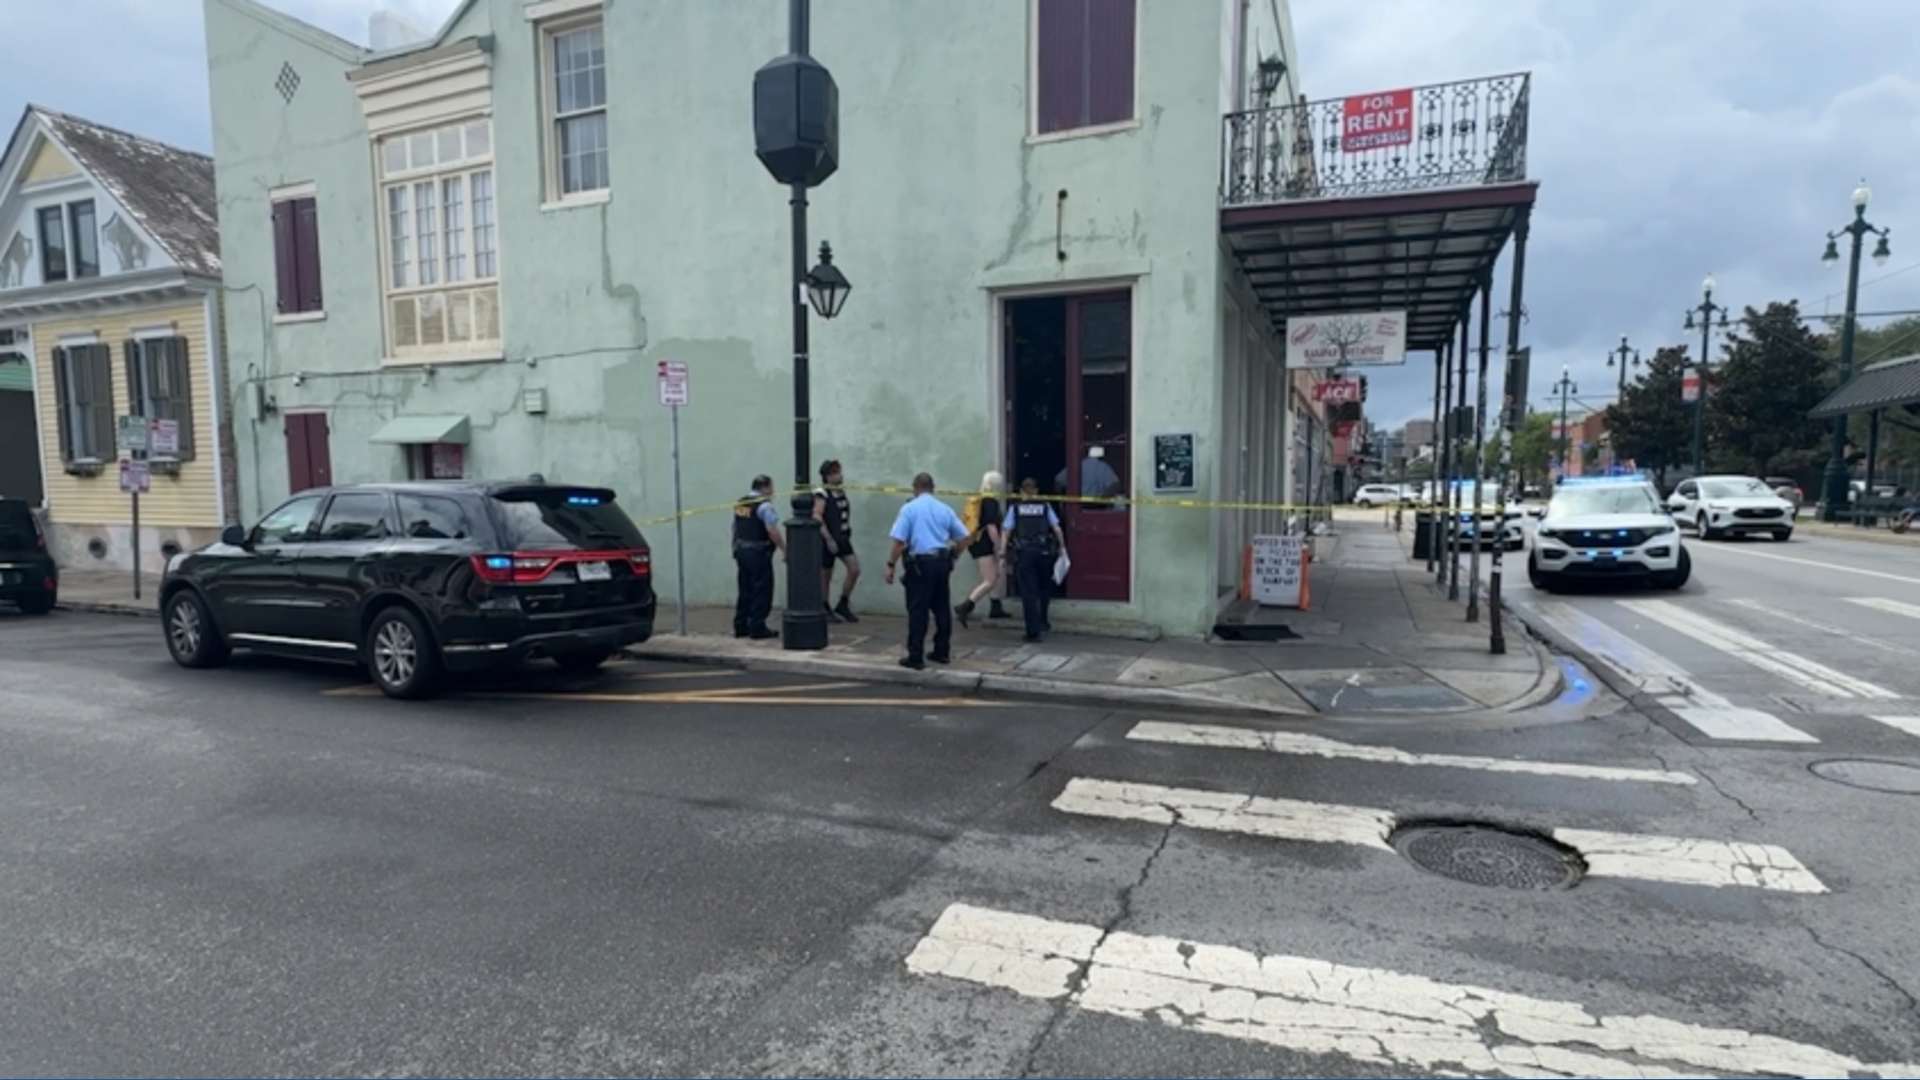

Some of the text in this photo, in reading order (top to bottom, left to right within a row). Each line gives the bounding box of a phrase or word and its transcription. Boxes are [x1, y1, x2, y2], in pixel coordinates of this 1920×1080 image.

[1362, 95, 1394, 110] FOR
[1347, 108, 1409, 133] RENT
[1321, 385, 1353, 400] ACE
